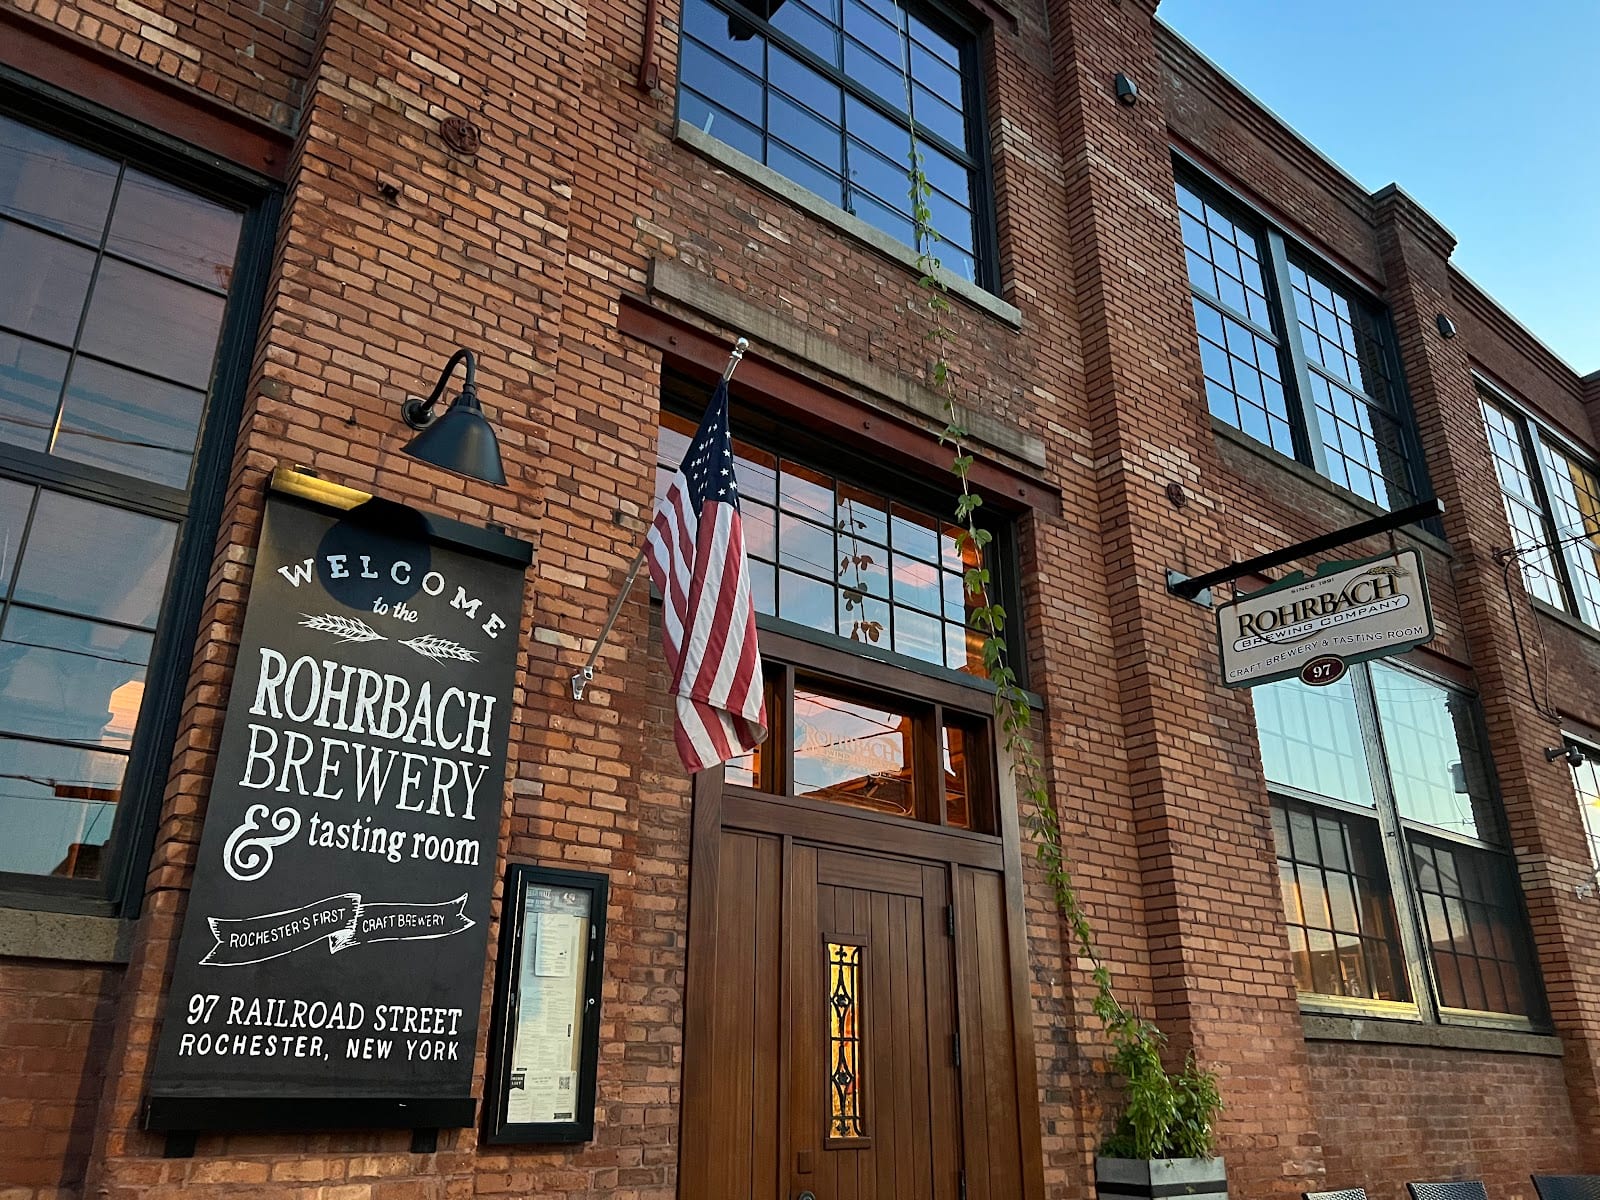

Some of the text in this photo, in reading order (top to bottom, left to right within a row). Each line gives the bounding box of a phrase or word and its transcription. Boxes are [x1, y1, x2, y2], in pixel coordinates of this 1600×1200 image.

[277, 554, 506, 639] WELCOME
[372, 597, 419, 623] to the
[1237, 574, 1399, 638] ROHRBACH
[1291, 584, 1315, 594] SINCE
[1242, 599, 1402, 648] BREWING COMPANY
[1229, 626, 1424, 678] CRAFT BREWERY & TASTING ROOM
[1312, 664, 1333, 678] 97
[249, 648, 497, 757] ROHRBACH
[239, 724, 489, 820] BREWERY
[224, 804, 480, 881] & tasting room
[230, 908, 445, 948] ROCHESTER'S FIRST CRAFT BREWERY
[187, 994, 462, 1036] 97 RAILROAD STREET
[179, 1034, 459, 1061] ROCHESTER, NEW YORK
